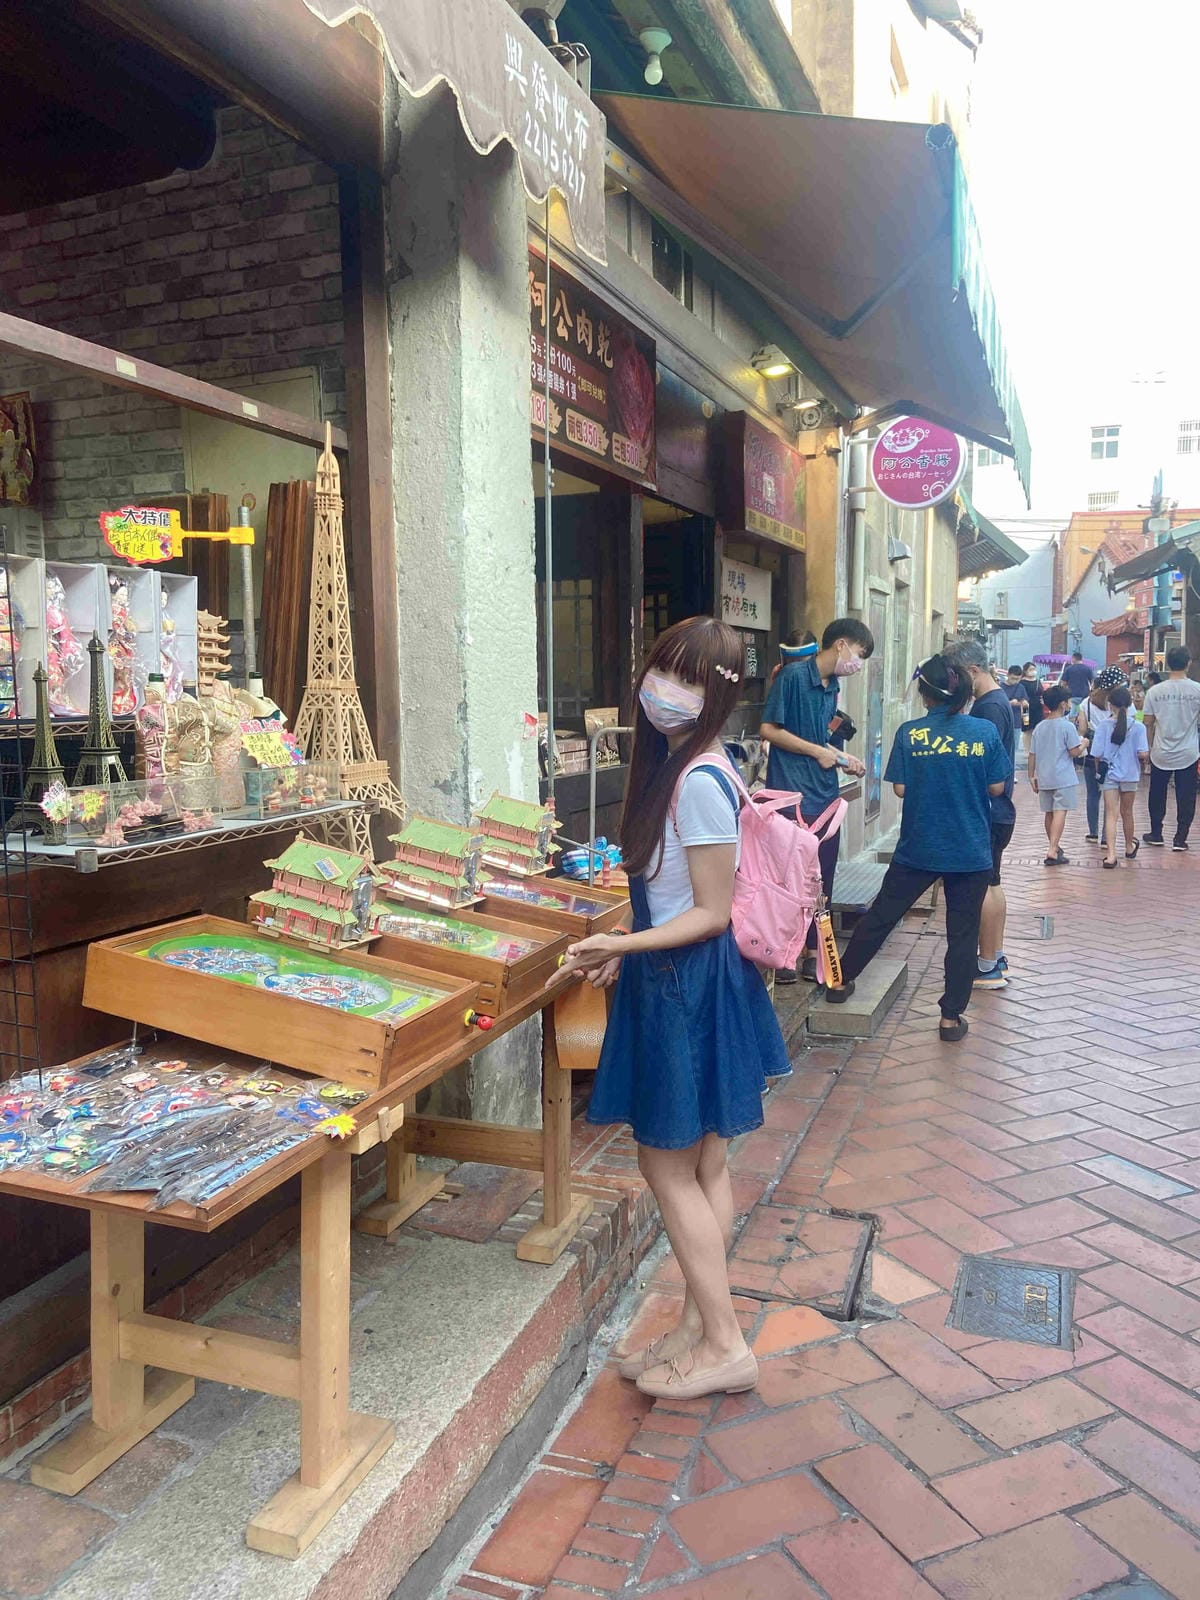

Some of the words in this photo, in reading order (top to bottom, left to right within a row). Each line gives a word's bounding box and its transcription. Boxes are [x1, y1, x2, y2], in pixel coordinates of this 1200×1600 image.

[528, 270, 614, 369] 阿公肉乾
[826, 943, 840, 982] PLAYBOY
